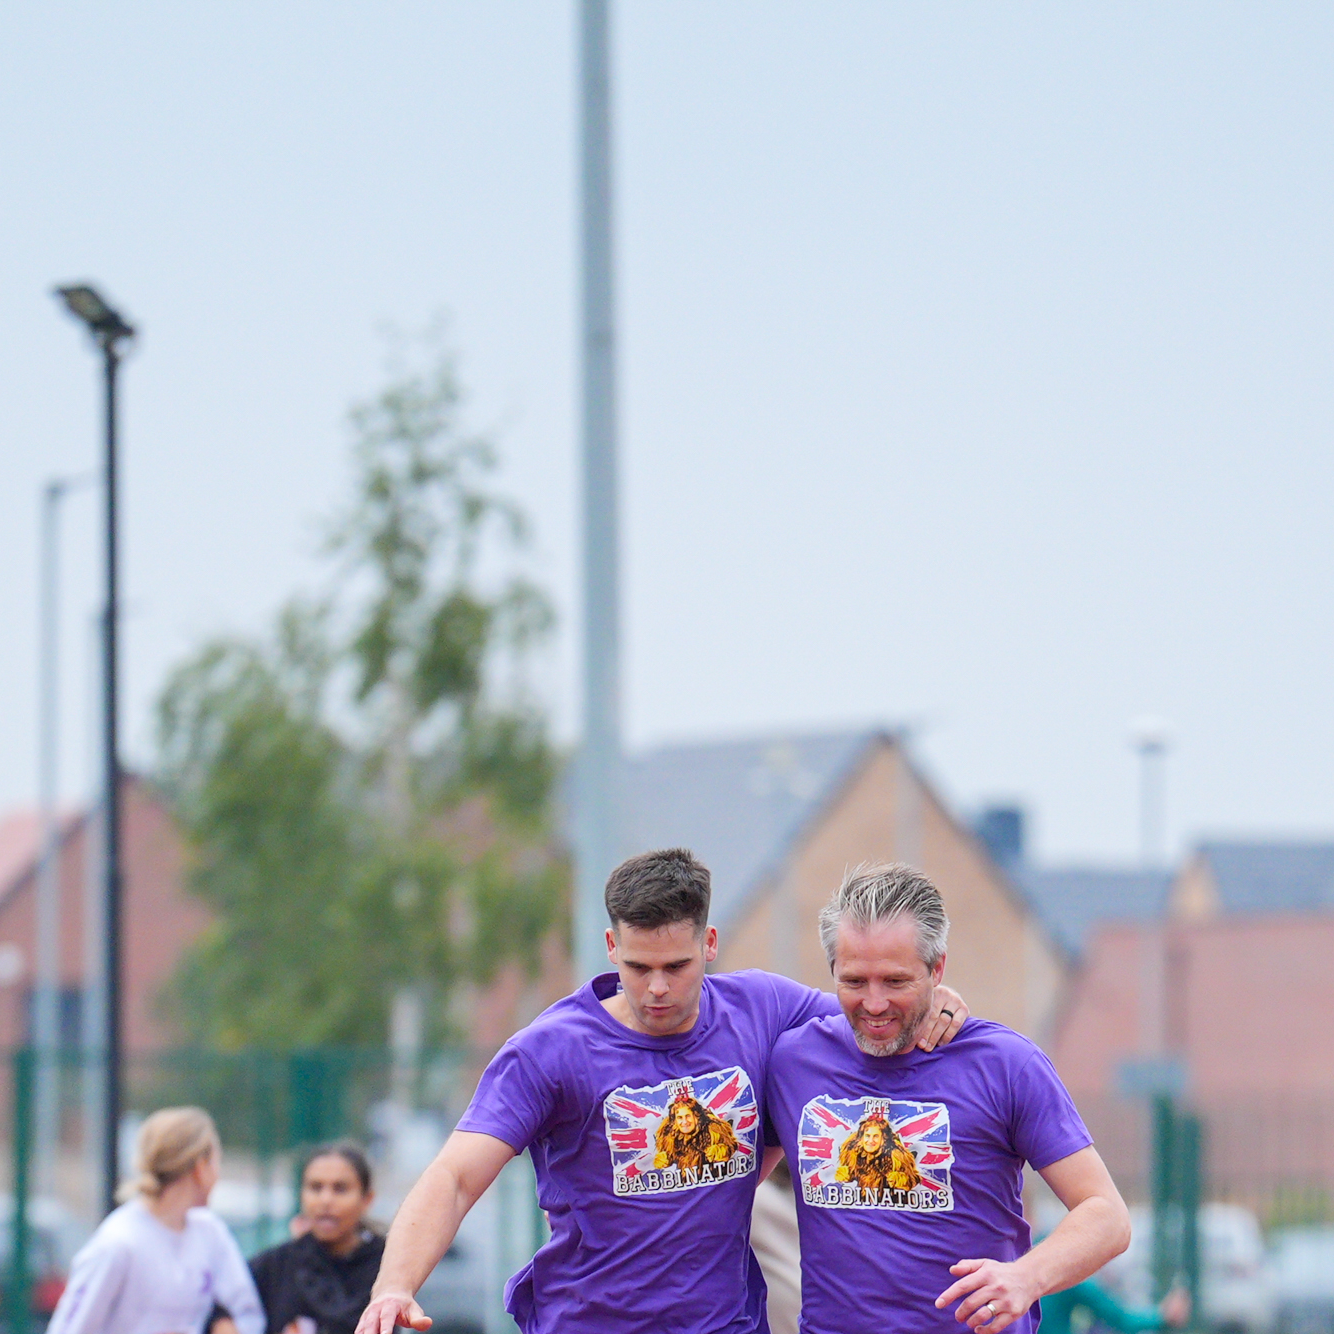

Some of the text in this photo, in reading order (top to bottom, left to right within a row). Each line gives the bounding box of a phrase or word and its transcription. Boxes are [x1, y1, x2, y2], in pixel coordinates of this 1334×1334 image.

[665, 1079, 695, 1096] THE
[863, 1099, 891, 1115] THE
[803, 1183, 949, 1208] BABBINATORS
